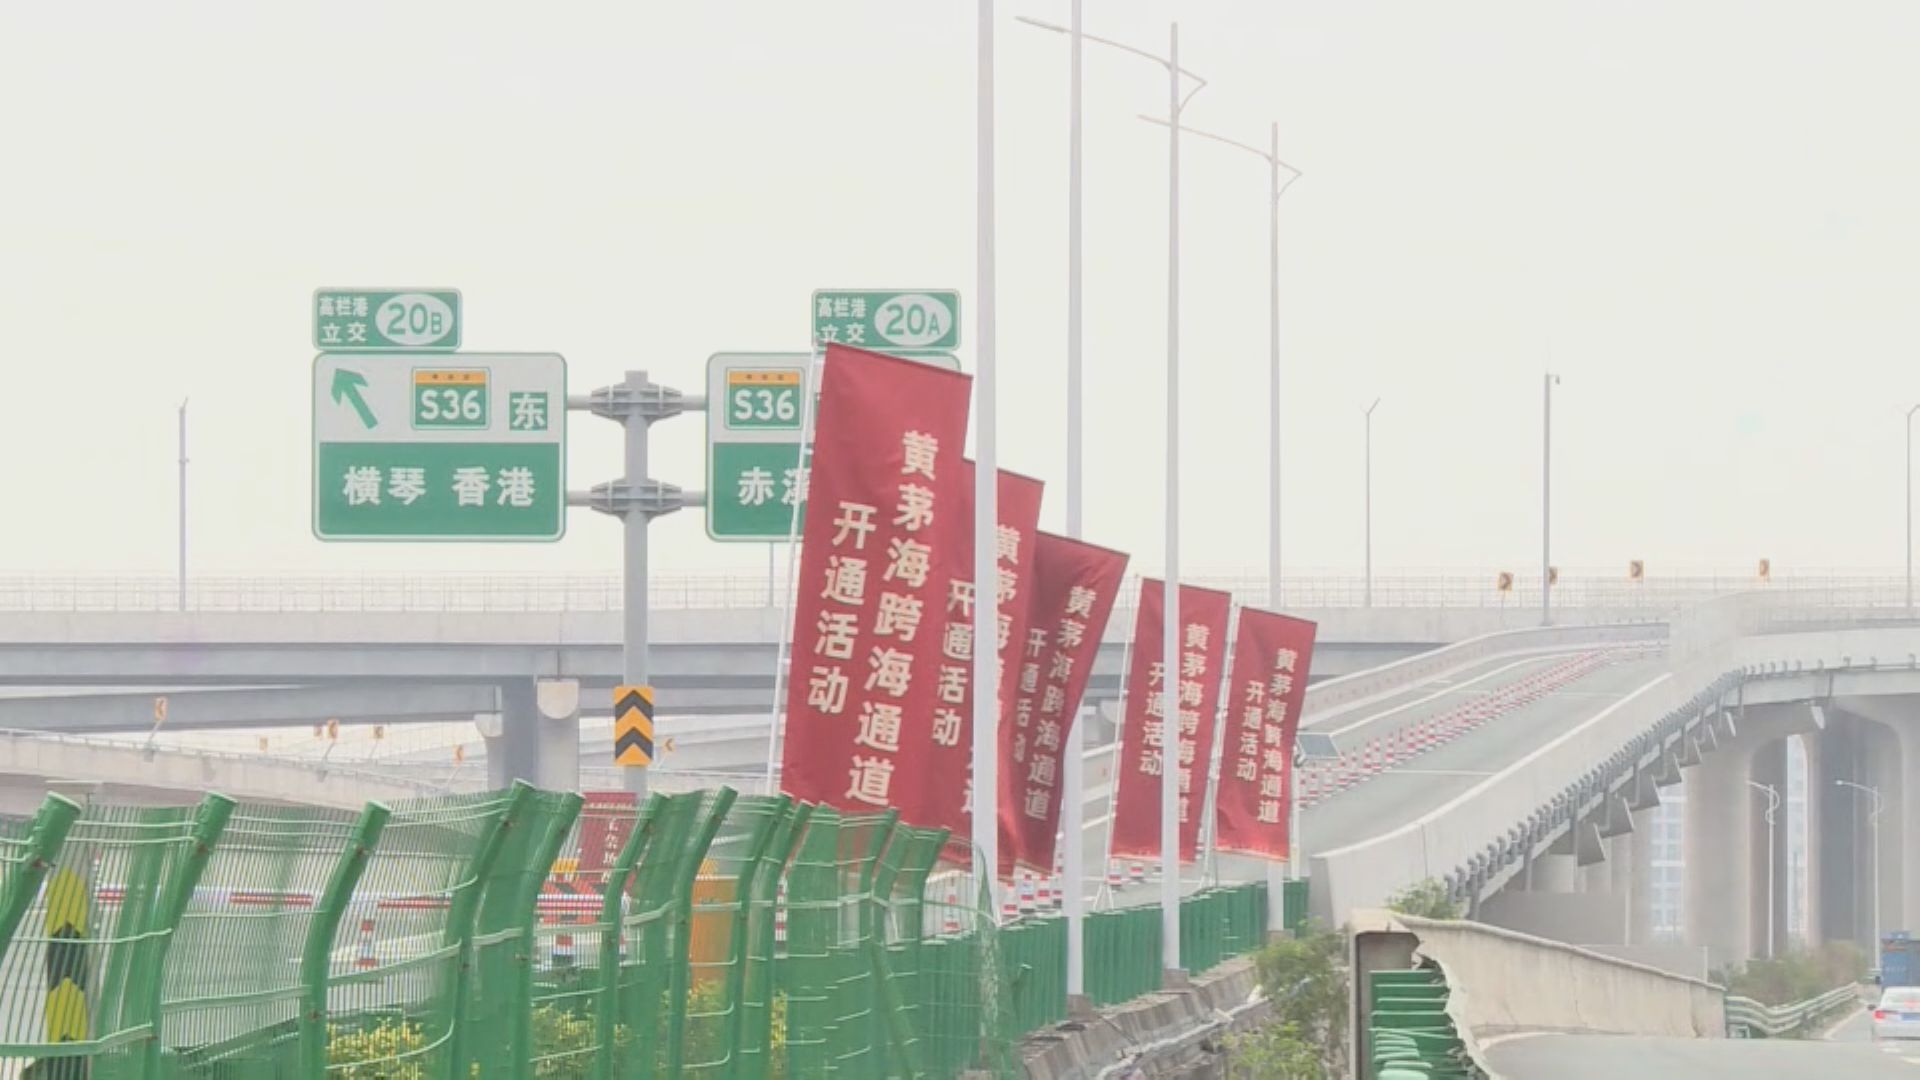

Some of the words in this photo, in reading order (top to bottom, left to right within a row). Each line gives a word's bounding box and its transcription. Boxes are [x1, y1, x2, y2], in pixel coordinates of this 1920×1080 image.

[319, 296, 368, 317] 高栏港
[386, 302, 442, 336] 20B
[817, 297, 866, 318] 高栏港
[885, 303, 941, 336] 20A
[320, 322, 368, 343] 立交
[820, 322, 865, 343] 立交
[420, 389, 481, 420] S36
[511, 393, 546, 429] 东
[734, 389, 795, 420] S36
[342, 466, 426, 506] 横琴
[452, 466, 535, 506] 香港
[807, 501, 877, 714] 开通活动
[845, 430, 939, 806] 黄茅海跨海通道
[932, 578, 975, 746] 开通活动
[1024, 586, 1097, 820] 黄茅海跨海通道
[1236, 680, 1265, 782] 开通活动
[1257, 648, 1298, 823] 黄茅海跨海通道
